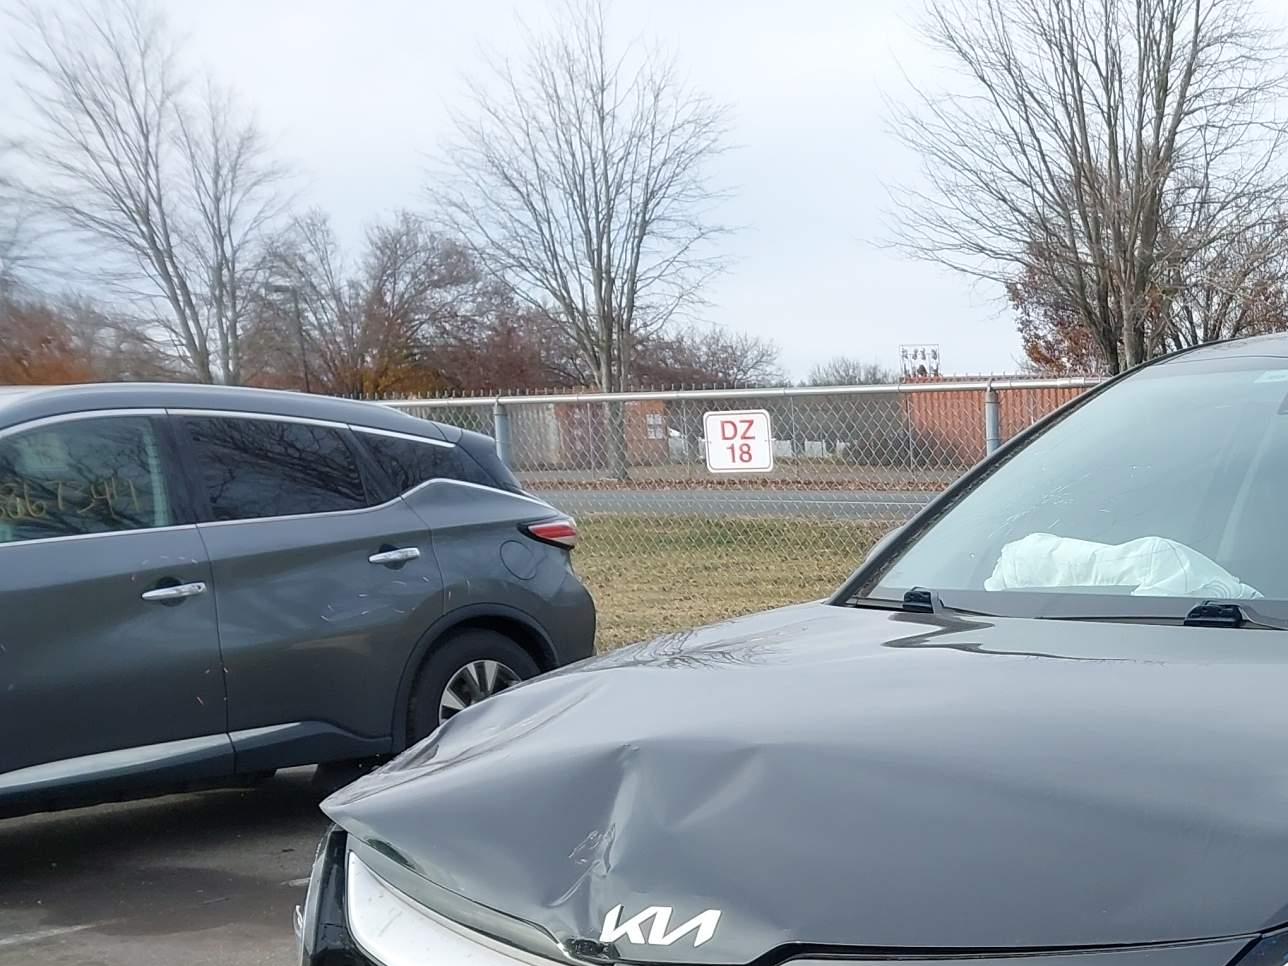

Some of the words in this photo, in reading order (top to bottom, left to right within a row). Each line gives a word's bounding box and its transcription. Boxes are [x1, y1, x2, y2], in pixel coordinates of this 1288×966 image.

[720, 419, 756, 441] DZ
[726, 443, 753, 464] 18
[599, 903, 722, 948] KIA
